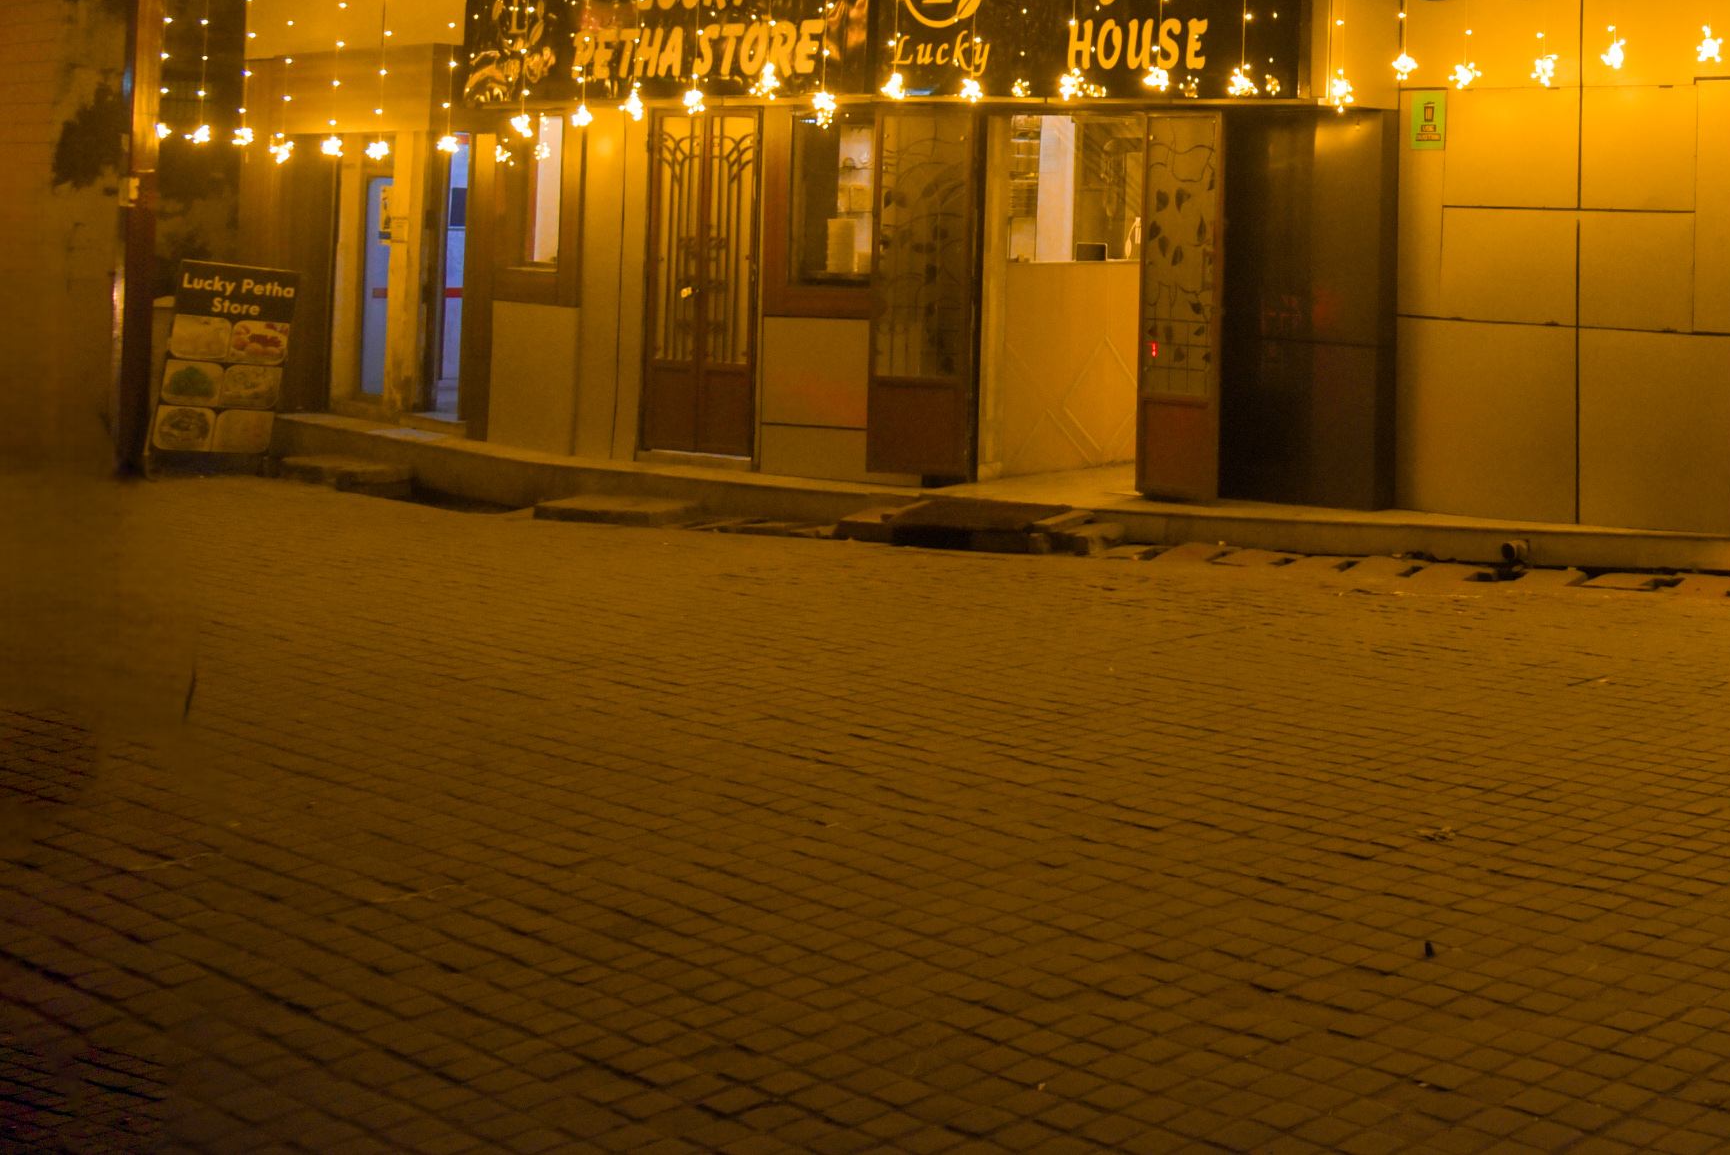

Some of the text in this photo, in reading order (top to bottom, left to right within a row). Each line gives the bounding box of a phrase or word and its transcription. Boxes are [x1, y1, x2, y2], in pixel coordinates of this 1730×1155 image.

[571, 19, 825, 80] PETHA STORE
[891, 30, 990, 76] Lucky
[1067, 18, 1208, 70] HOUSE
[183, 273, 295, 298] Lucky Petha
[211, 298, 260, 316] Store
